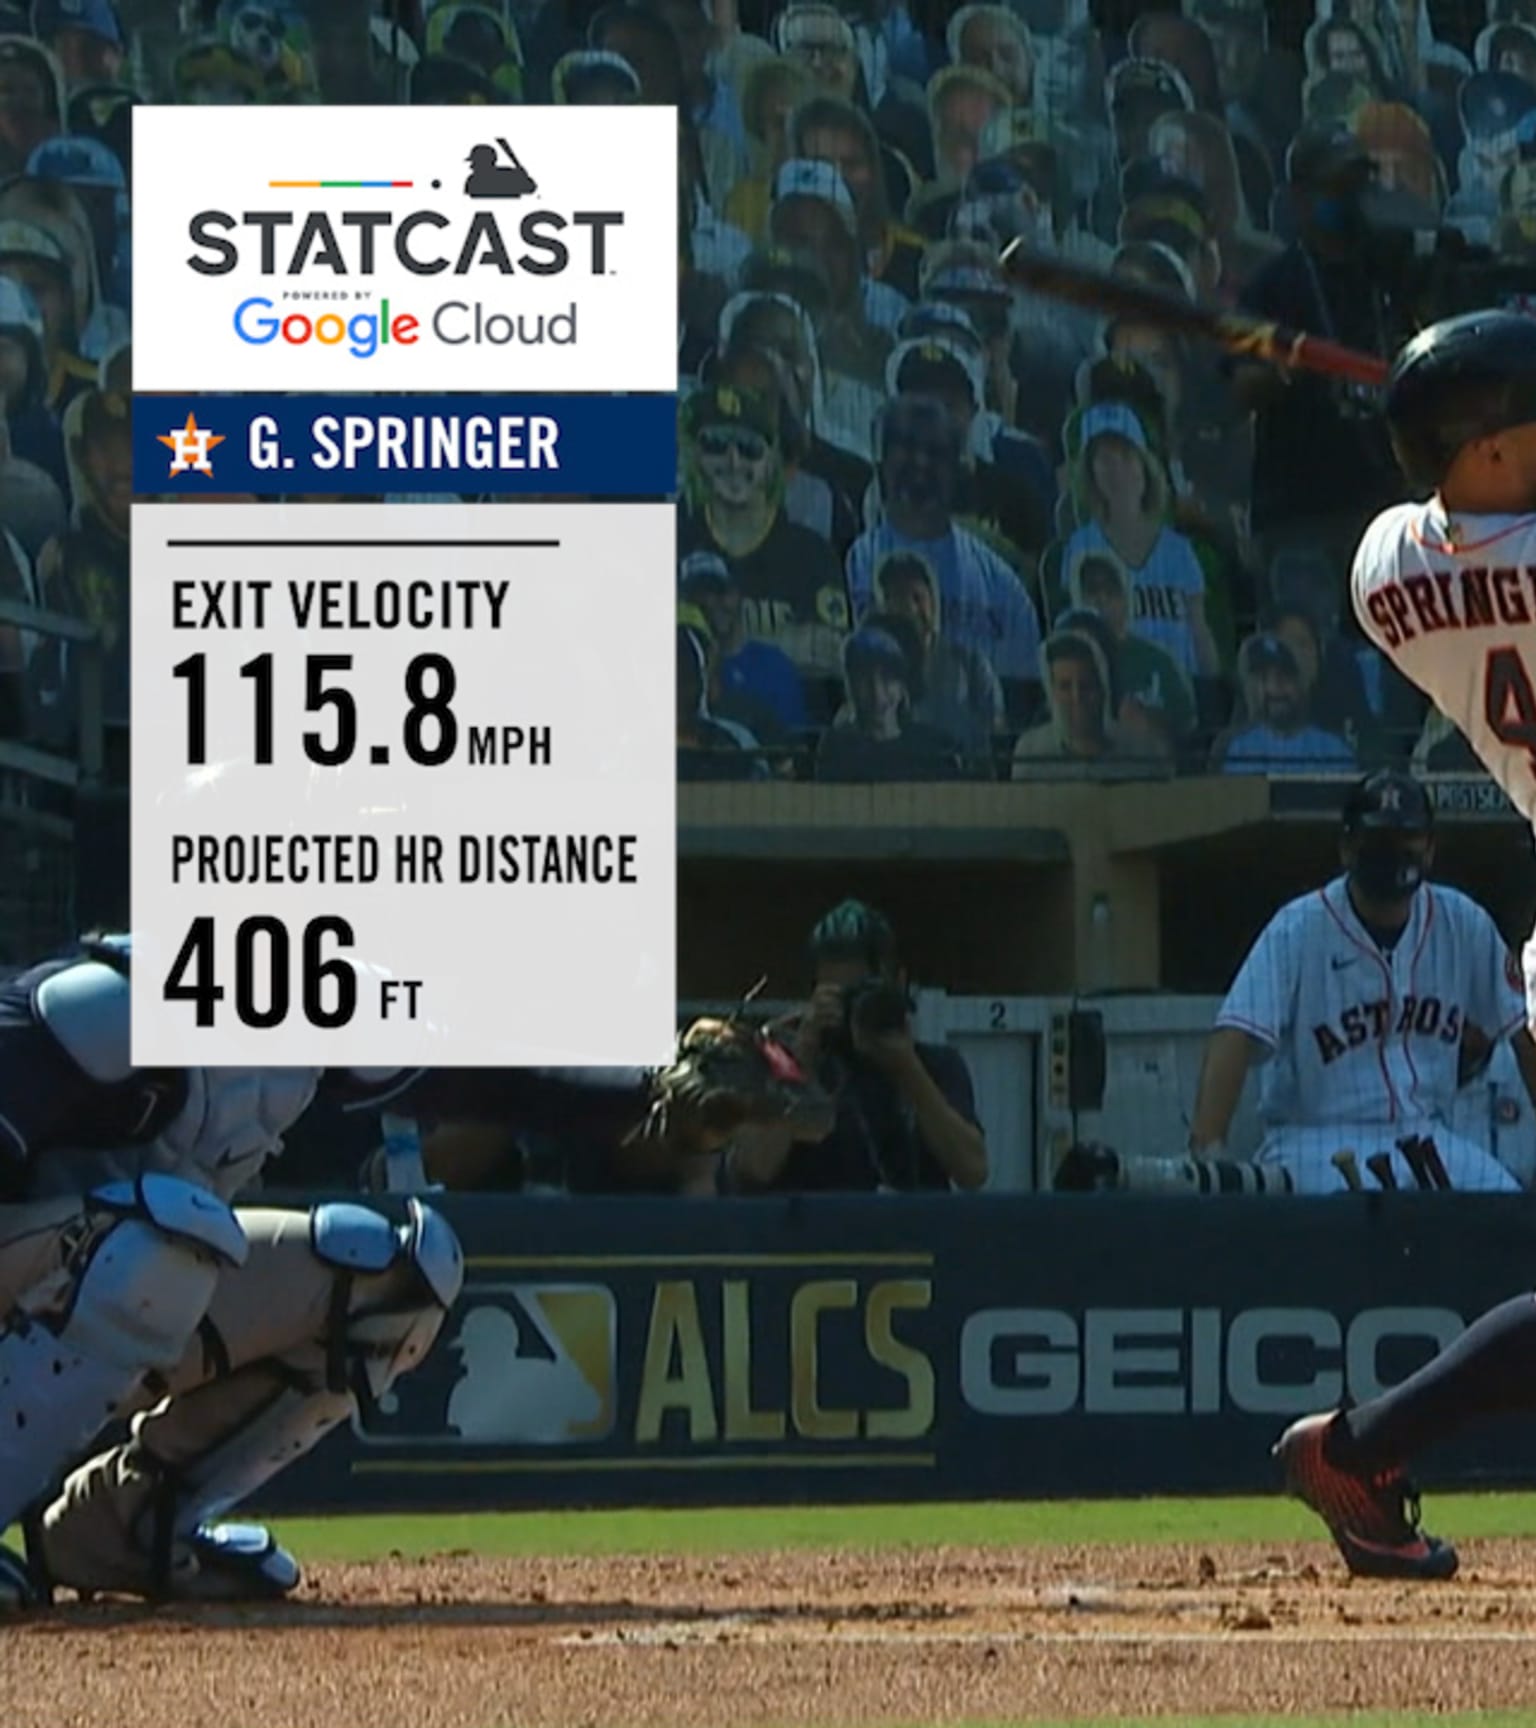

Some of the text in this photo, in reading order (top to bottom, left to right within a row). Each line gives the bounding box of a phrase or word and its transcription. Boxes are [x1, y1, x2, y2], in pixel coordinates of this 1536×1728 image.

[989, 1002, 1007, 1029] 2
[1314, 997, 1458, 1064] ASTROS
[635, 1279, 936, 1442] ALCS
[959, 1306, 1465, 1414] GEICO
